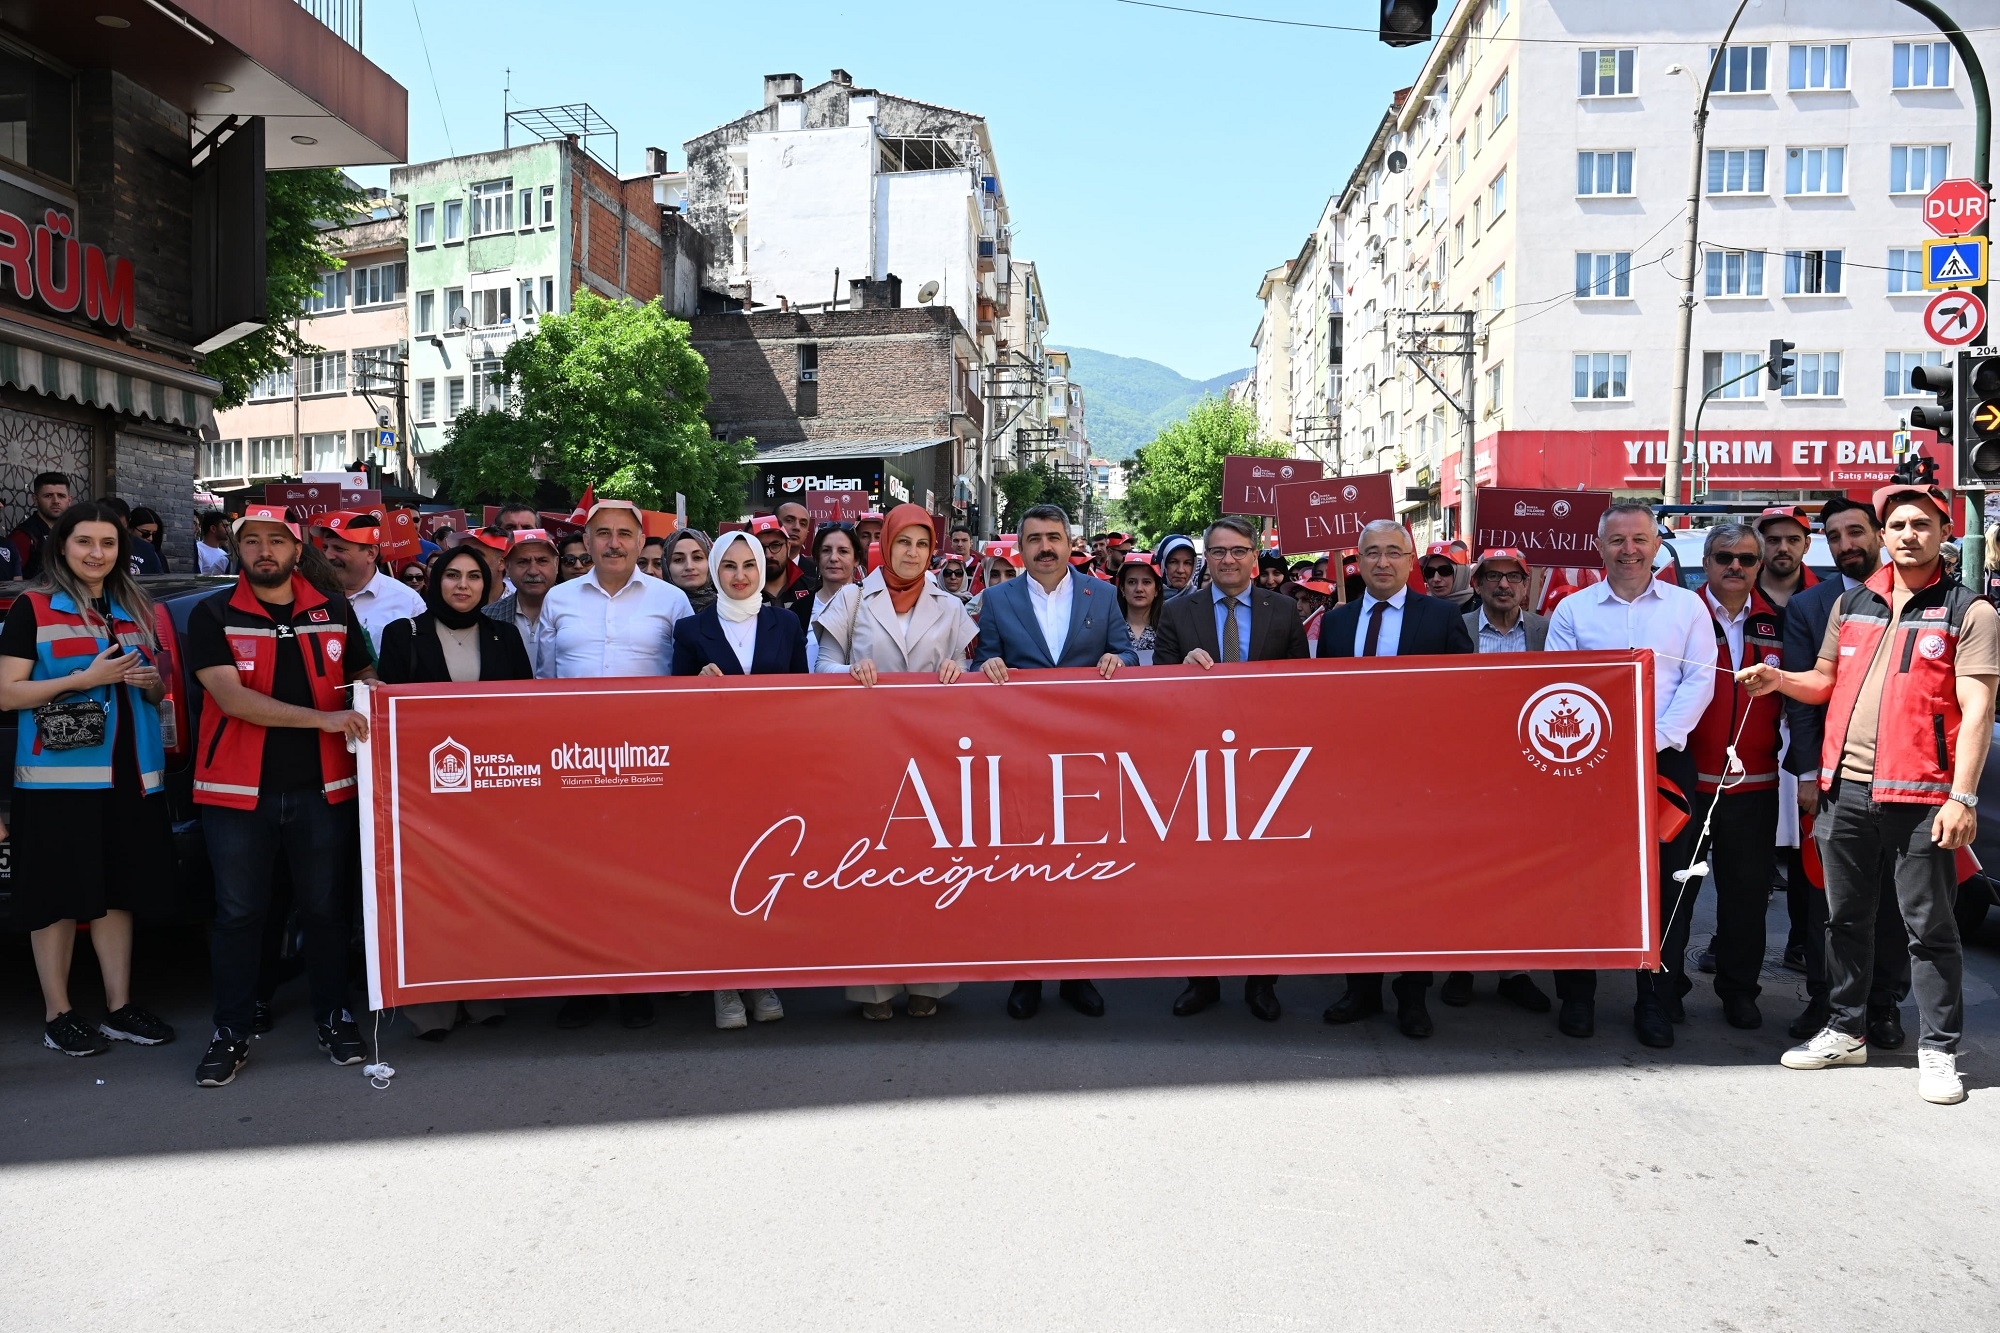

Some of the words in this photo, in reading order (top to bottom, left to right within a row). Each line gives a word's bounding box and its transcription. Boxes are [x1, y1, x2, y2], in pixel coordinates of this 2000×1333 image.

[1929, 197, 1982, 218] DUR
[1792, 441, 1827, 464] ET
[805, 475, 862, 490] Polisan
[1838, 472, 1861, 480] Satış
[282, 504, 328, 519] AYGI
[1304, 511, 1367, 538] EMEK
[1478, 528, 1599, 551] FEDAKÂRLIK
[473, 754, 514, 764] BURSA
[1522, 748, 1548, 771] 2025
[1553, 767, 1582, 776] AİLE
[1587, 748, 1608, 768] YILI
[474, 765, 541, 777] YILDIRIM
[561, 777, 592, 785] Yıldırım
[594, 776, 629, 785] Belediye
[631, 775, 664, 784] Başkanı
[474, 778, 541, 788] BELEDİYESİ
[874, 729, 1313, 850] AİLEMİZ
[730, 815, 1135, 921] Geleceğimiz
